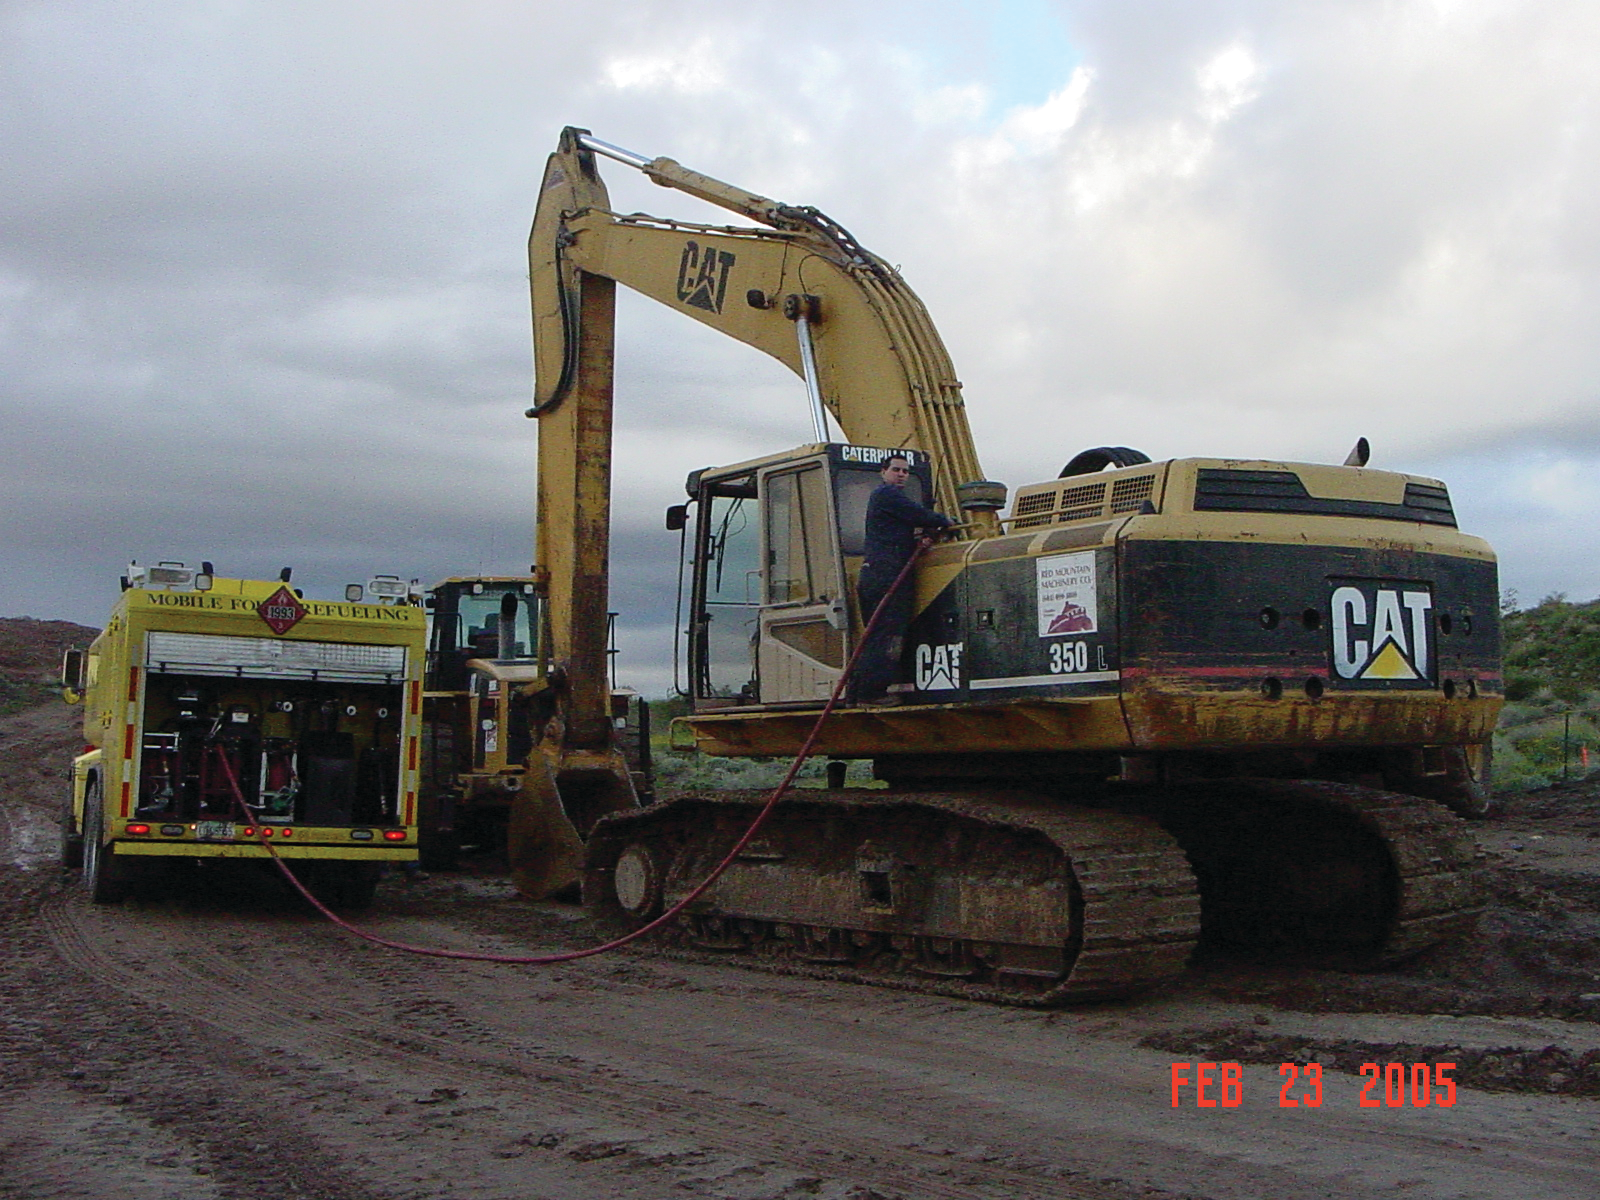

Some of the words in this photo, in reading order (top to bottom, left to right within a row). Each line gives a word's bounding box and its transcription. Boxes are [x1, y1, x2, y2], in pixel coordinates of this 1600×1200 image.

[676, 240, 736, 315] CAT
[147, 593, 222, 610] MOBILE
[231, 599, 260, 611] FO
[302, 604, 409, 620] REFUELING
[270, 607, 294, 619] 1993
[1331, 586, 1432, 679] CAT
[916, 642, 963, 690] CAT
[1049, 641, 1088, 674] 350
[1097, 645, 1108, 670] L
